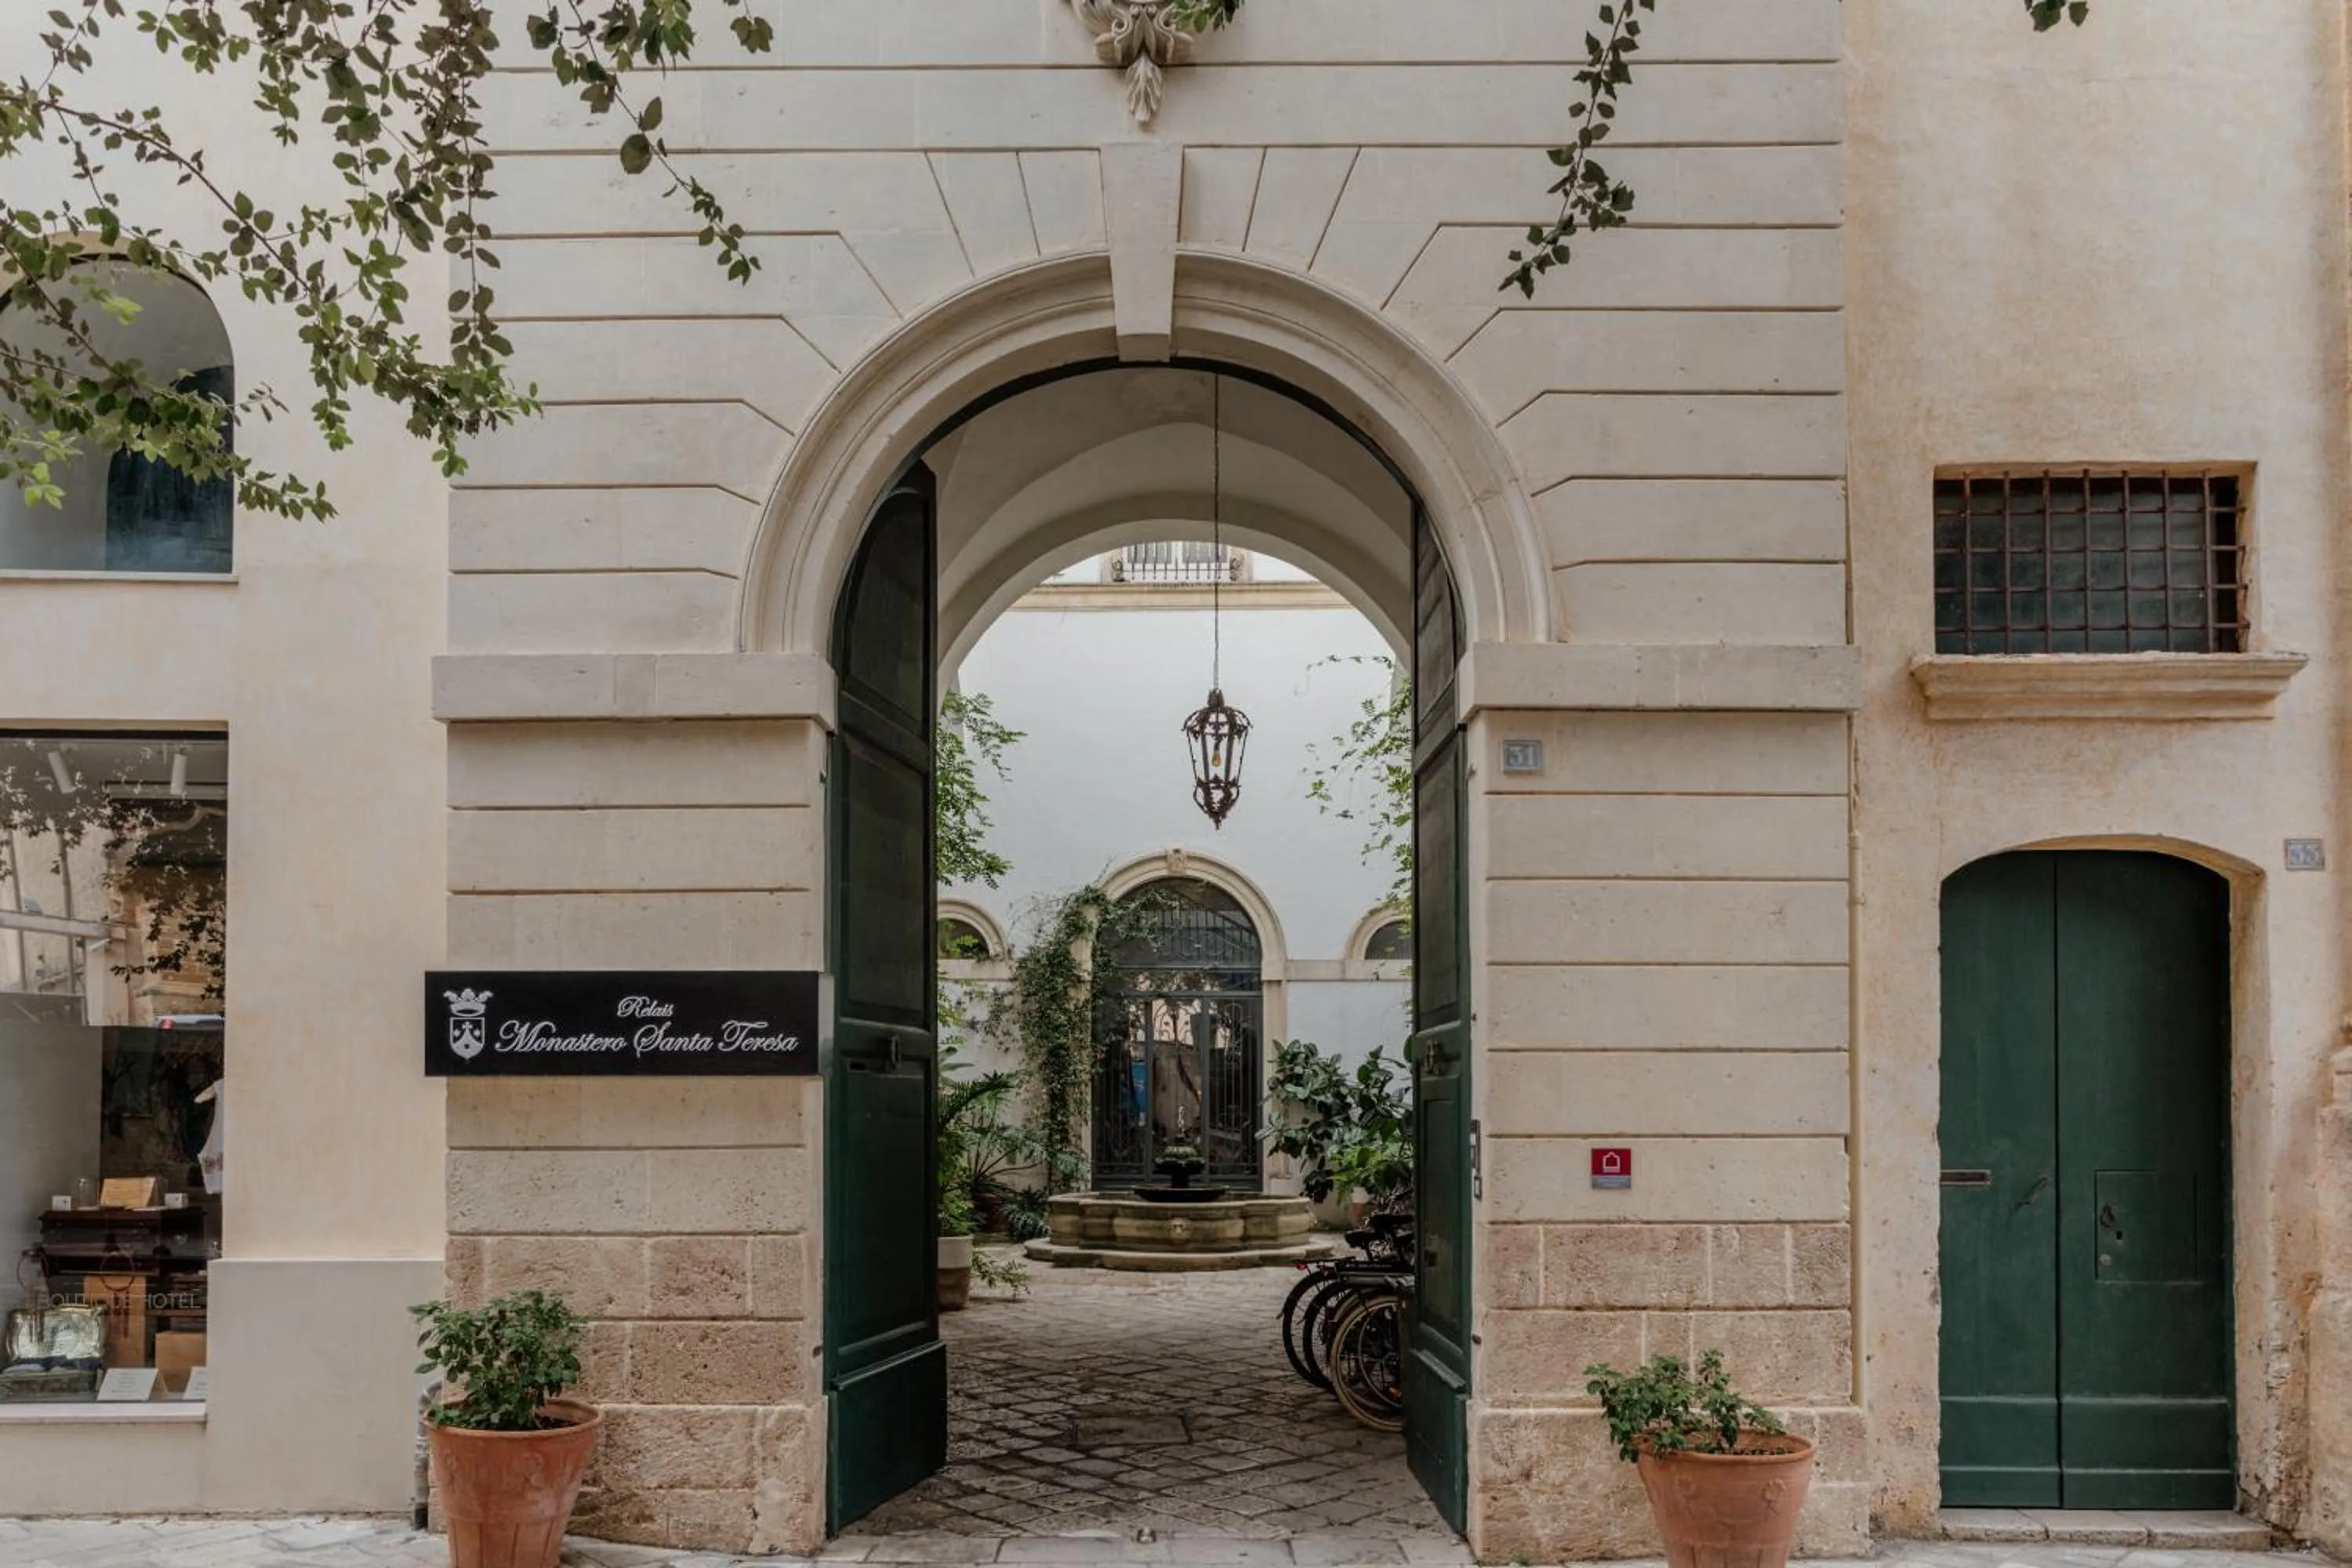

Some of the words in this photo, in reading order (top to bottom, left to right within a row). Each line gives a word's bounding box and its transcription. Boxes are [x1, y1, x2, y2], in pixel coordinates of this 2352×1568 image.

[1508, 746, 1534, 766] 31
[617, 996, 674, 1018] Relais
[495, 1020, 627, 1052] Monastero
[633, 1021, 714, 1058] Santa
[718, 1020, 799, 1052] Teresa
[140, 1294, 201, 1308] HOTEL
